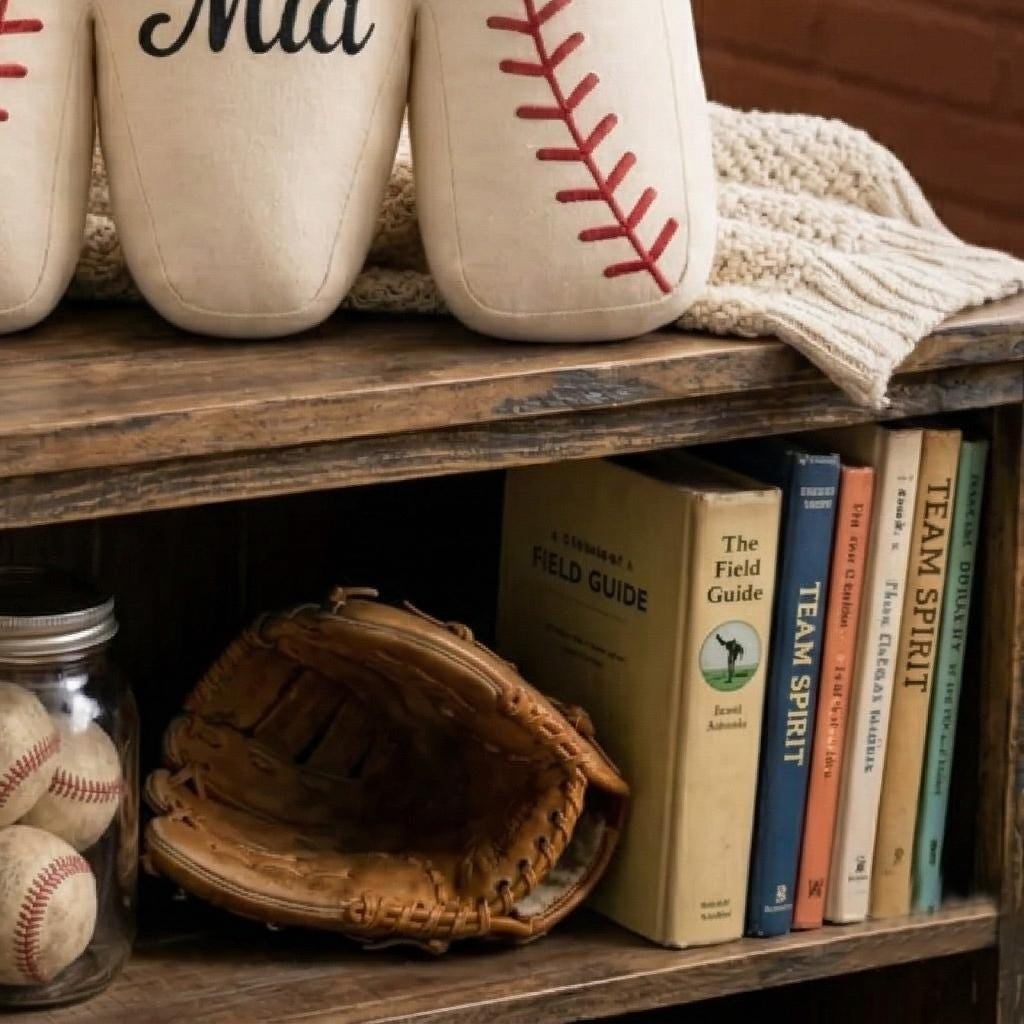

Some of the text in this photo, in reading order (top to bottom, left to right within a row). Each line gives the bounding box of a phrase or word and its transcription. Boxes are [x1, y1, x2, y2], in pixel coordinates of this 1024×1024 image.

[721, 534, 759, 553] The
[532, 544, 583, 584] FIELD
[588, 569, 649, 613] GUIDE
[714, 559, 761, 579] Field
[904, 477, 952, 693] TEAM SPIRIT
[707, 584, 764, 604] Guide
[783, 581, 822, 767] TEAM SPIRIT
